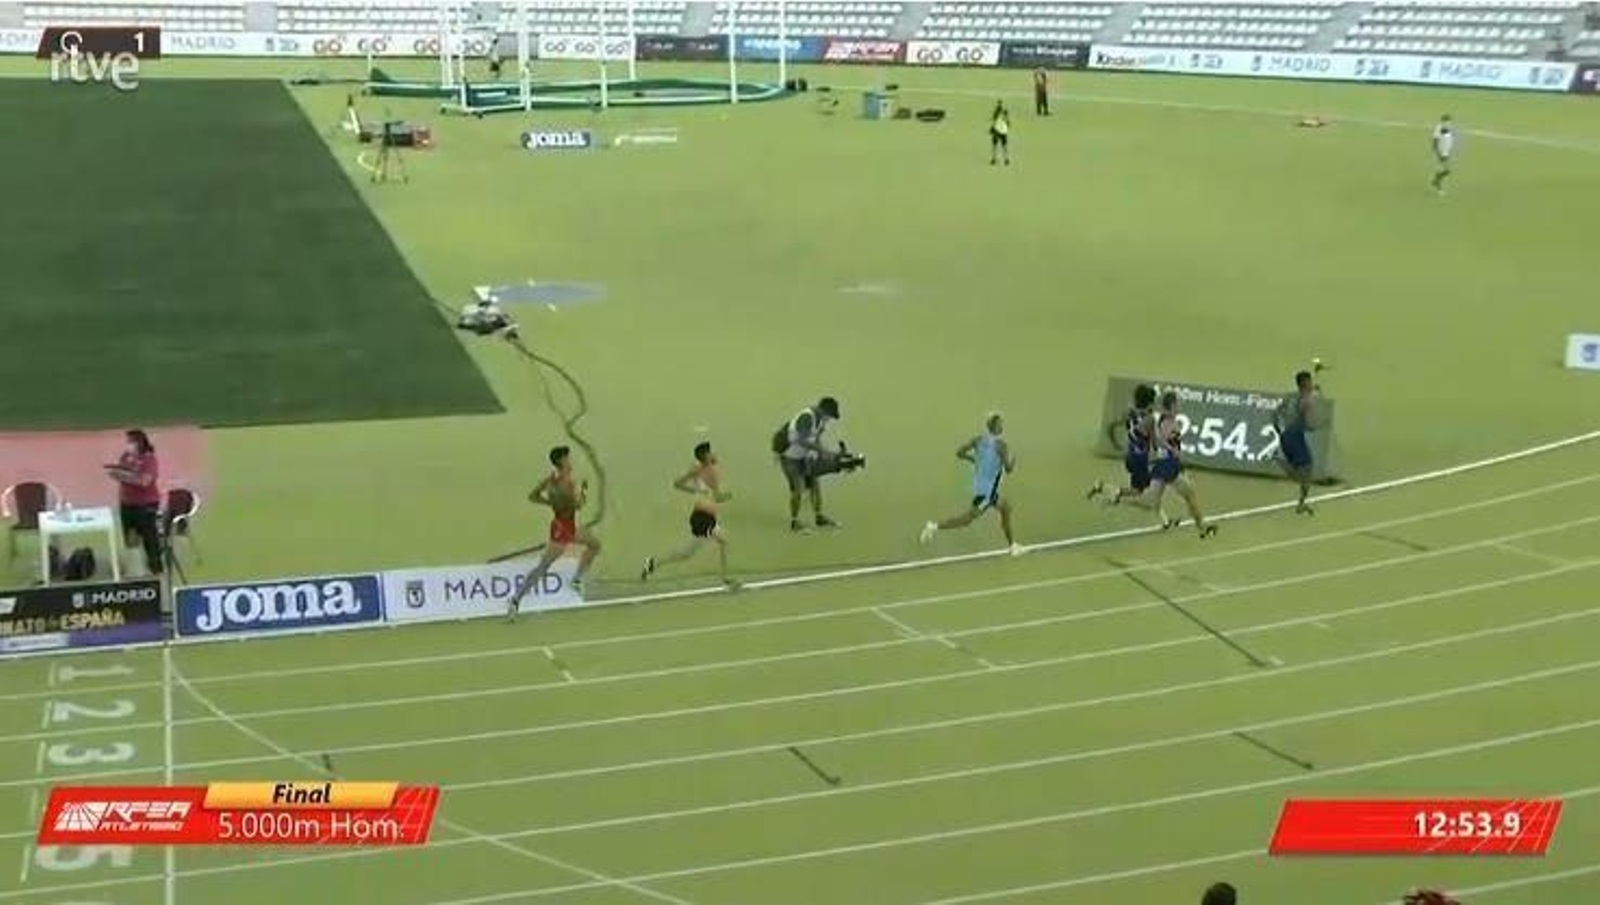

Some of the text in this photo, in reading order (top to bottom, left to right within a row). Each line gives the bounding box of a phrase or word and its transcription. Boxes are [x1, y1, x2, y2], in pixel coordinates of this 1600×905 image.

[92, 588, 157, 604] MADRID
[52, 699, 136, 722] 2
[48, 741, 137, 765] 3
